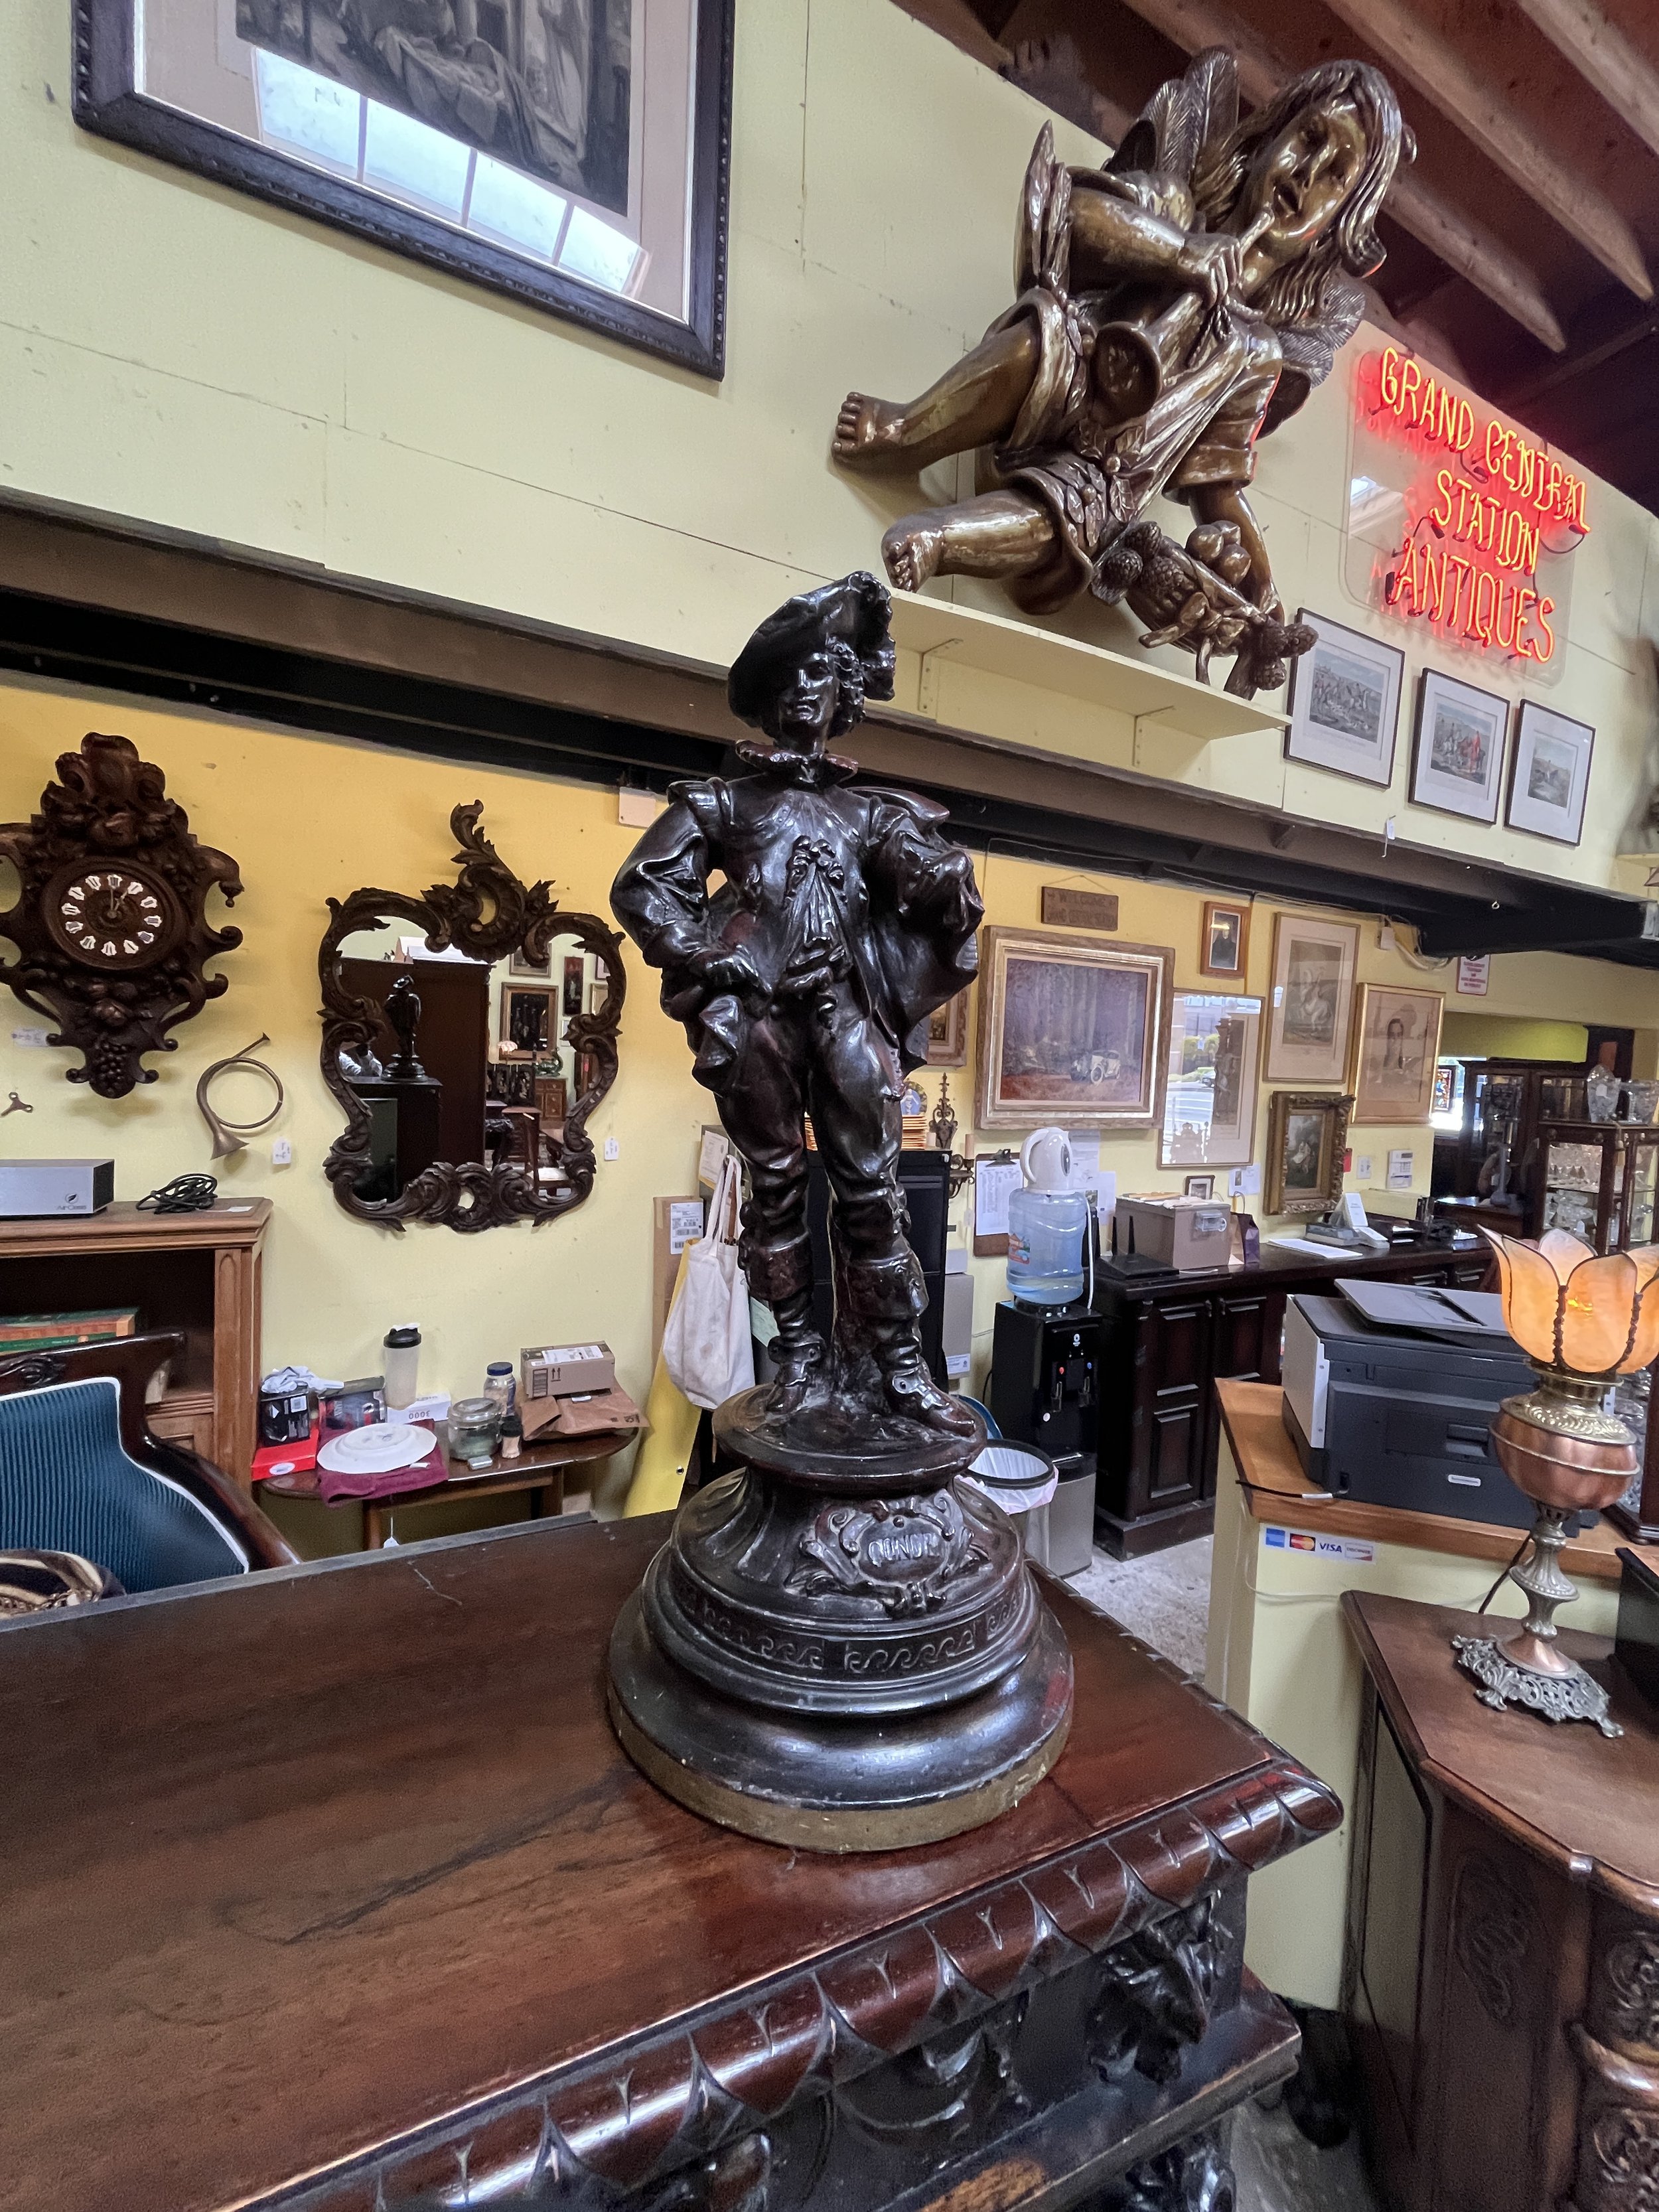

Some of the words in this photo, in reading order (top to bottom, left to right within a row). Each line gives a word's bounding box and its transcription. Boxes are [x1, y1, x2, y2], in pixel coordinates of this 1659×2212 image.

[1380, 346, 1475, 451] GRAND
[1485, 420, 1591, 533] CENTRAL
[1429, 469, 1540, 575] STATION
[1392, 537, 1555, 663] ANTIQUES
[1319, 1542, 1342, 1553] VISA
